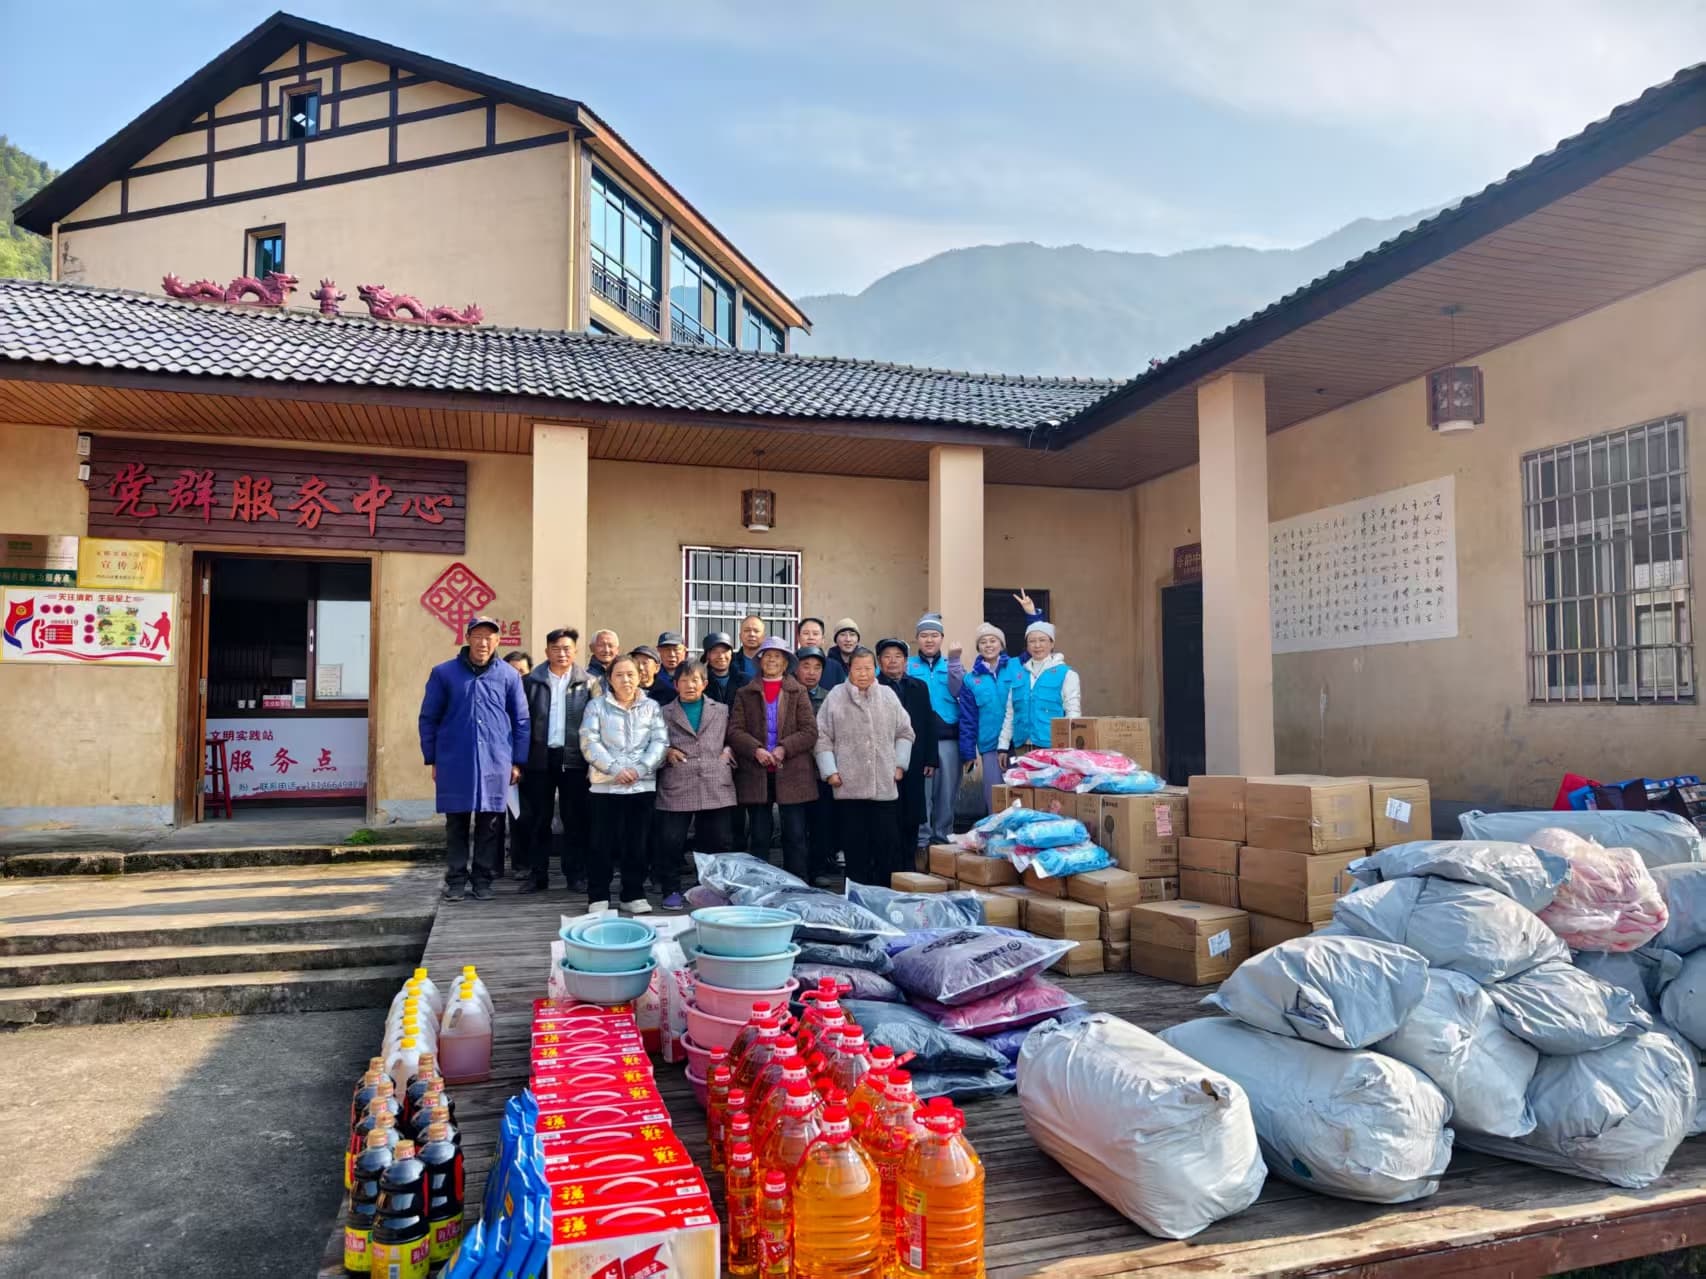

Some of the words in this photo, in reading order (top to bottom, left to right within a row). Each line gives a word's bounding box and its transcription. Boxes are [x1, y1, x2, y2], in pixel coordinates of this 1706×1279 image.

[109, 463, 454, 537] 党群服务中心
[209, 729, 274, 742] 文明实践站
[205, 747, 338, 775] 服务点
